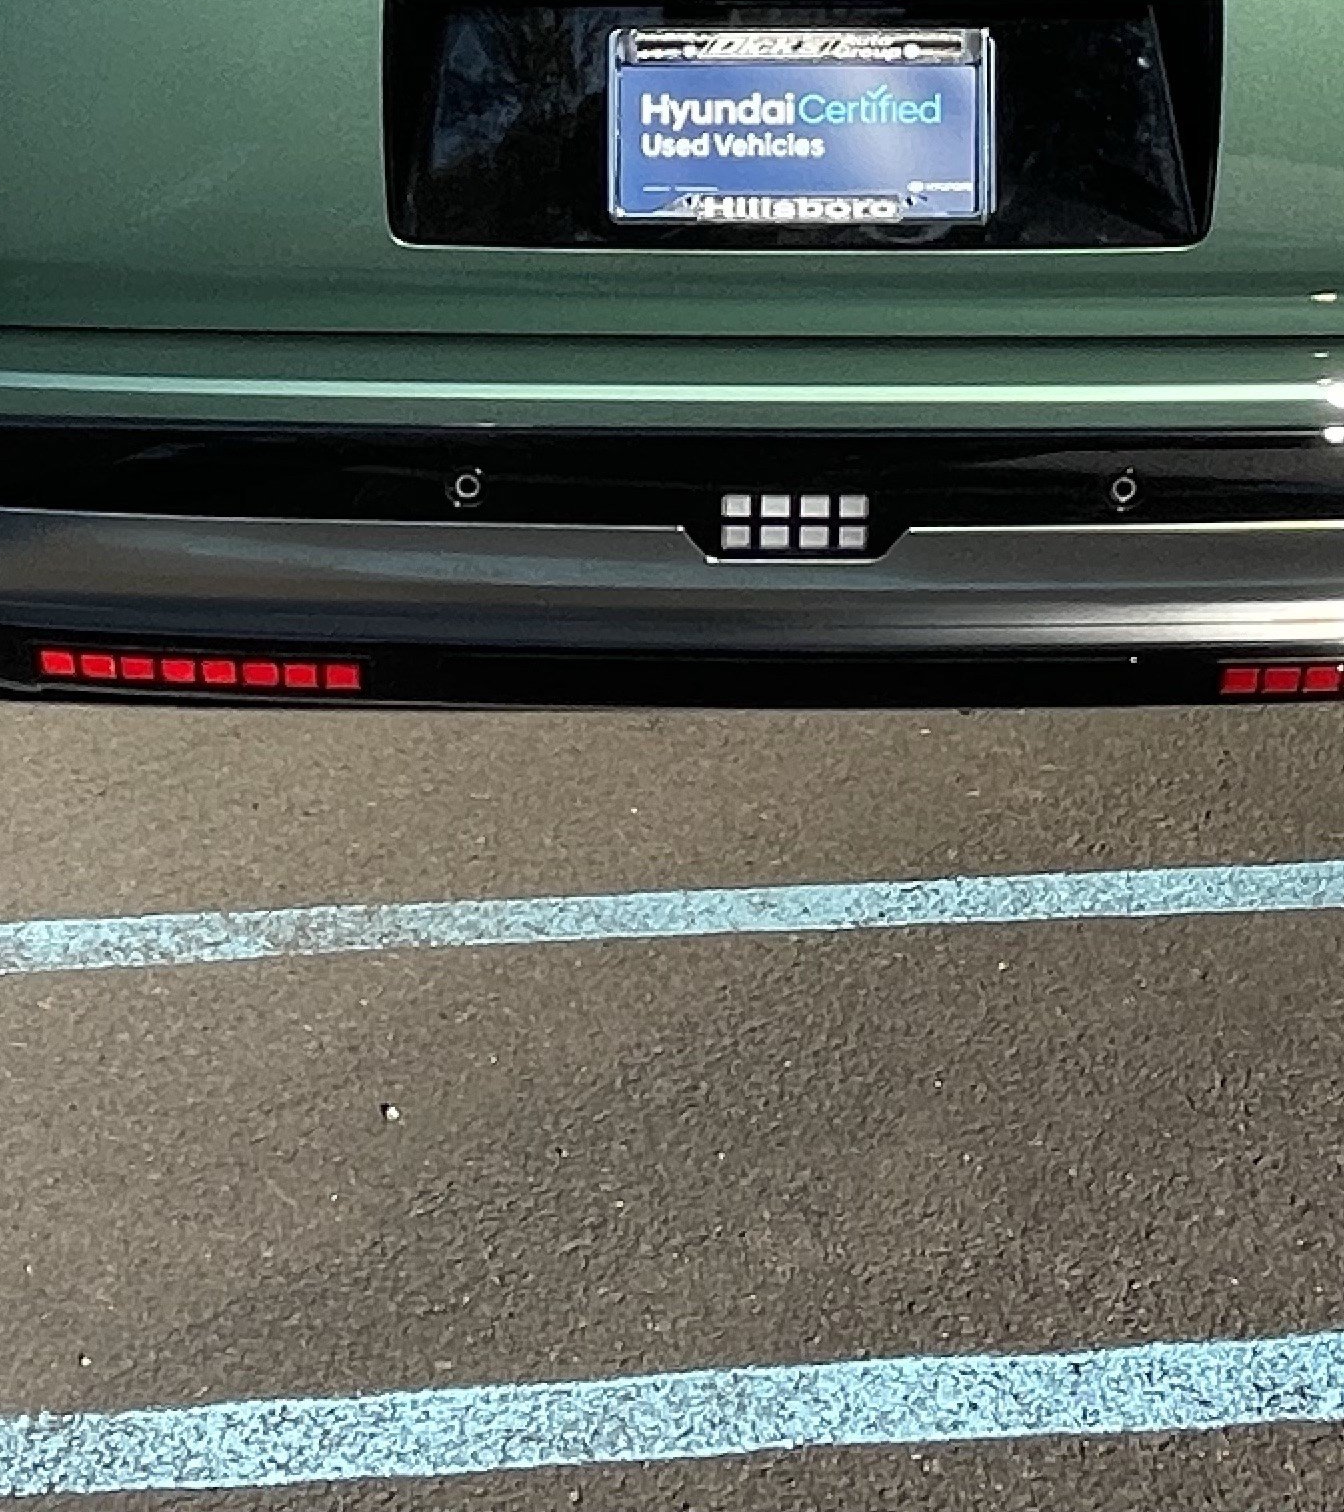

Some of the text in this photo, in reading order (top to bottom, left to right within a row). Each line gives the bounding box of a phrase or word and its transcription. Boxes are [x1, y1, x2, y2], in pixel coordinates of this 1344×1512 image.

[640, 133, 826, 158] Used Vehicles
[702, 196, 898, 220] Hillsboro
